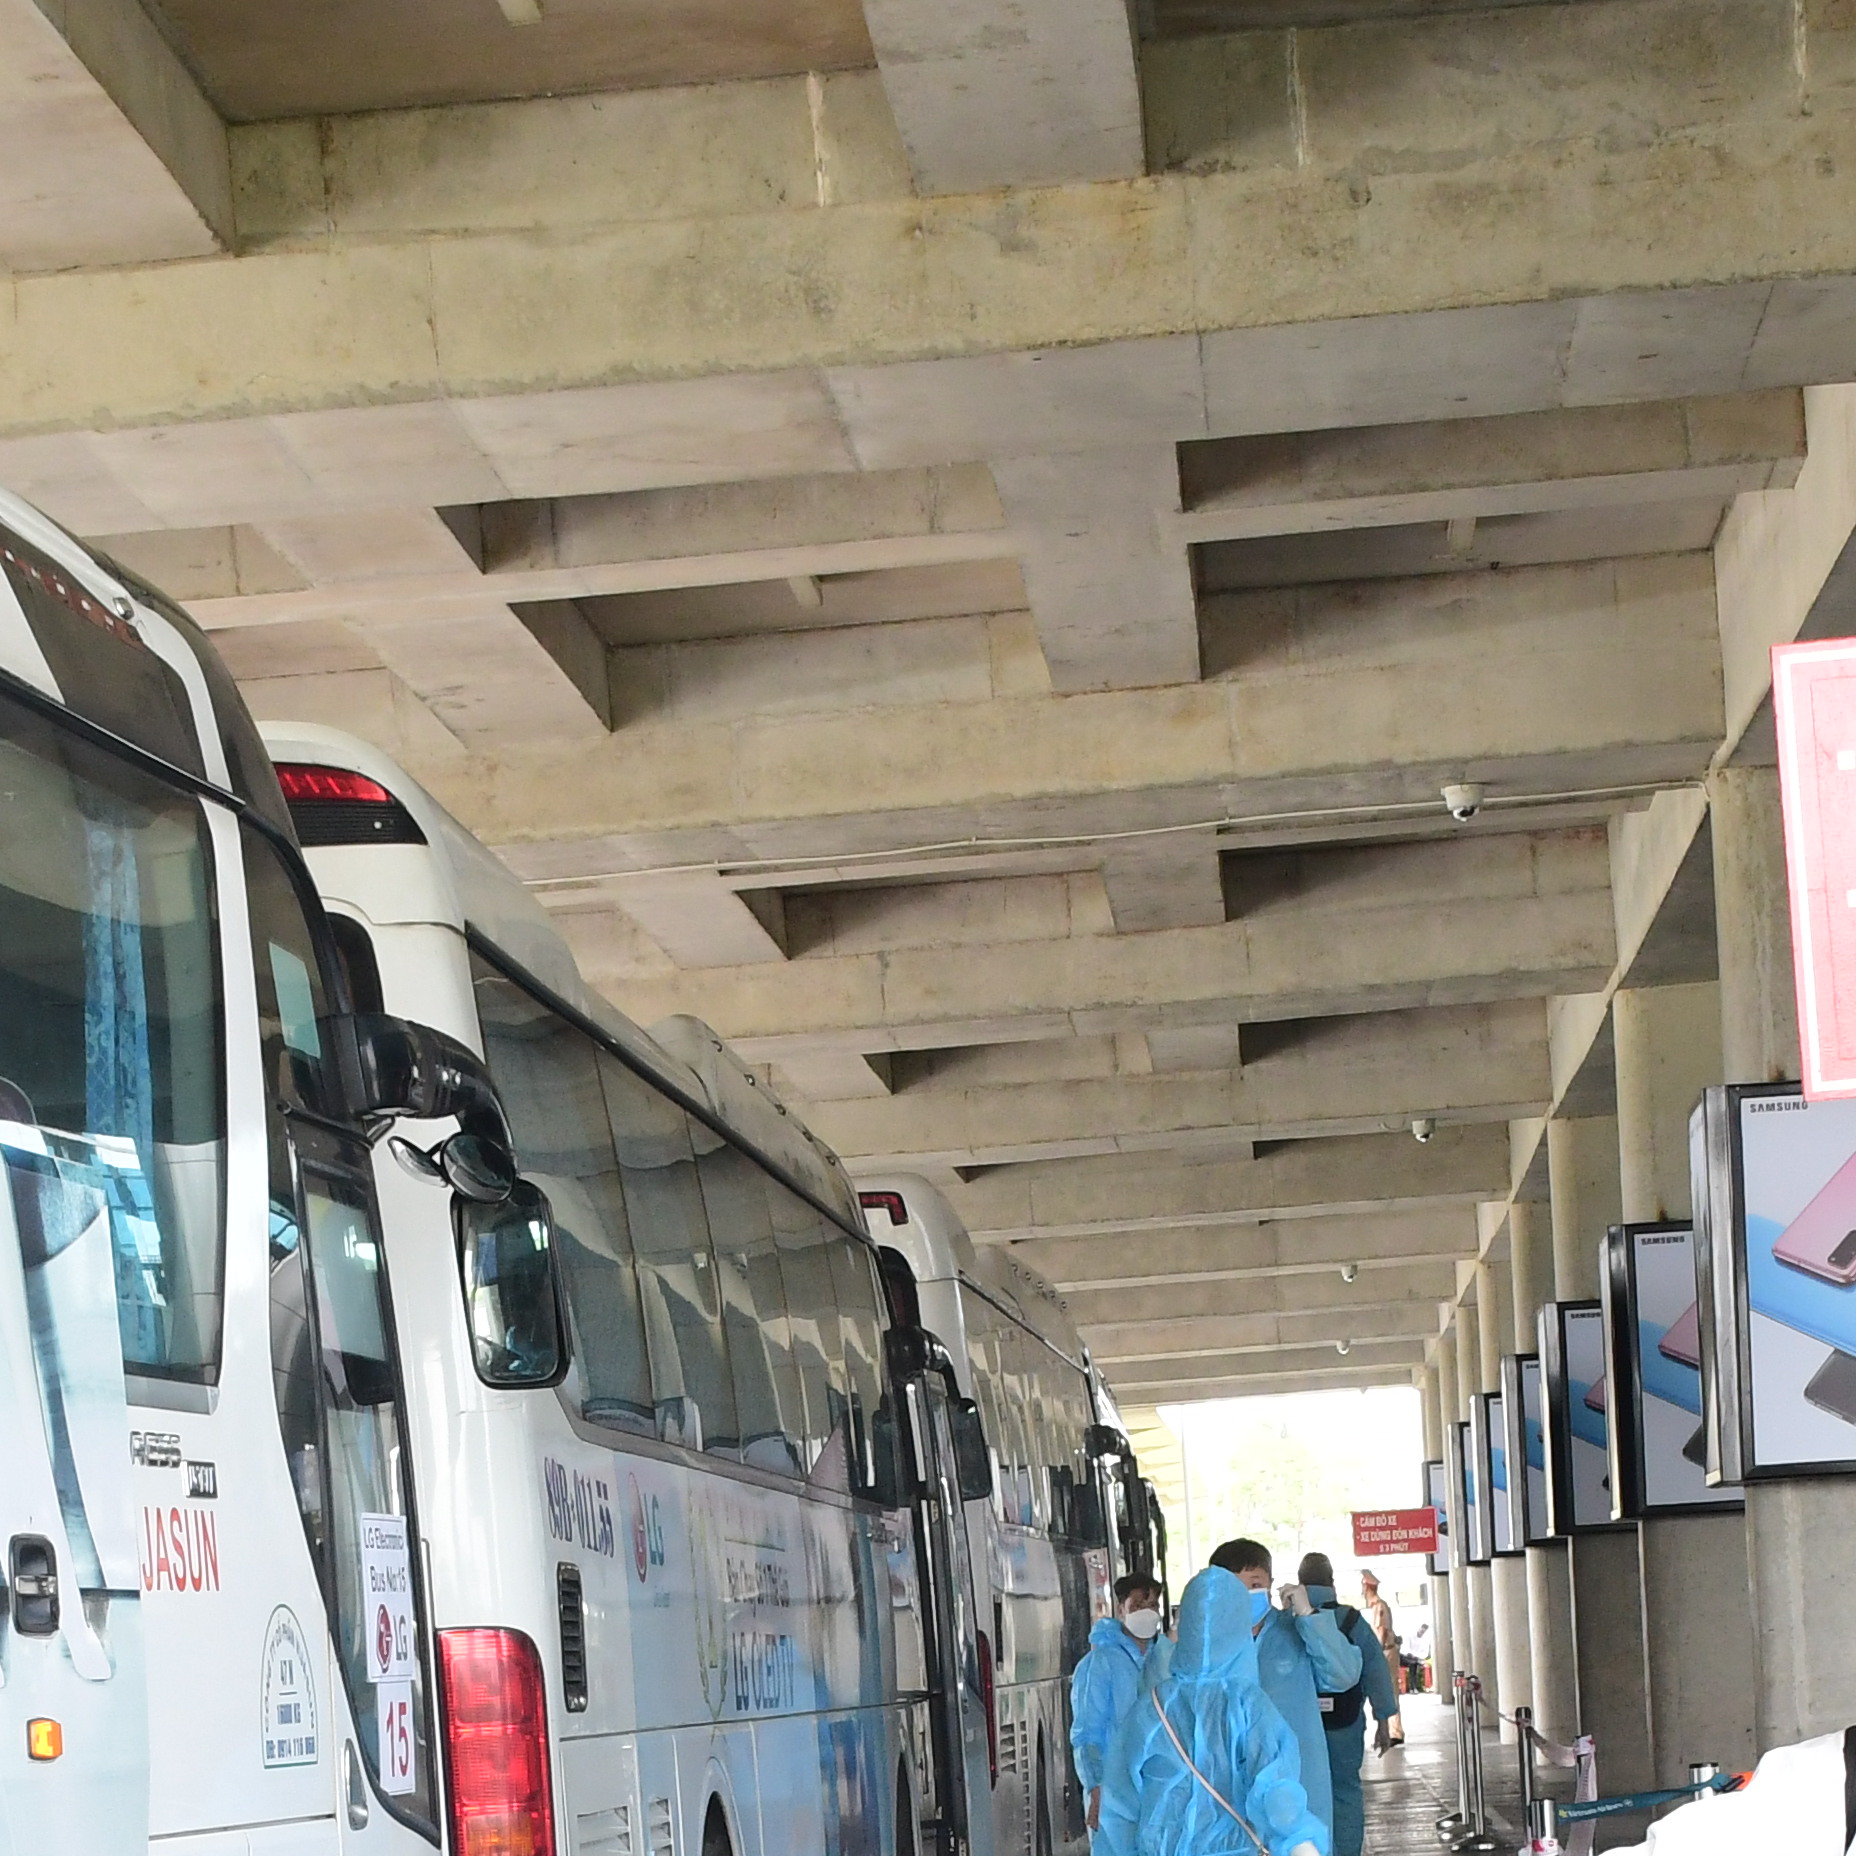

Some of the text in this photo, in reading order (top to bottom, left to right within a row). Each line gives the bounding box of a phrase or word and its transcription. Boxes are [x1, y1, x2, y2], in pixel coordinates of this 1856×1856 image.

[1750, 1101, 1808, 1113] SAMSUNG
[1641, 1235, 1685, 1245] SAMSUNG
[363, 1527, 375, 1548] LG
[370, 1566, 386, 1592] Bus
[393, 1614, 408, 1661] LG
[386, 1701, 409, 1777] 15
